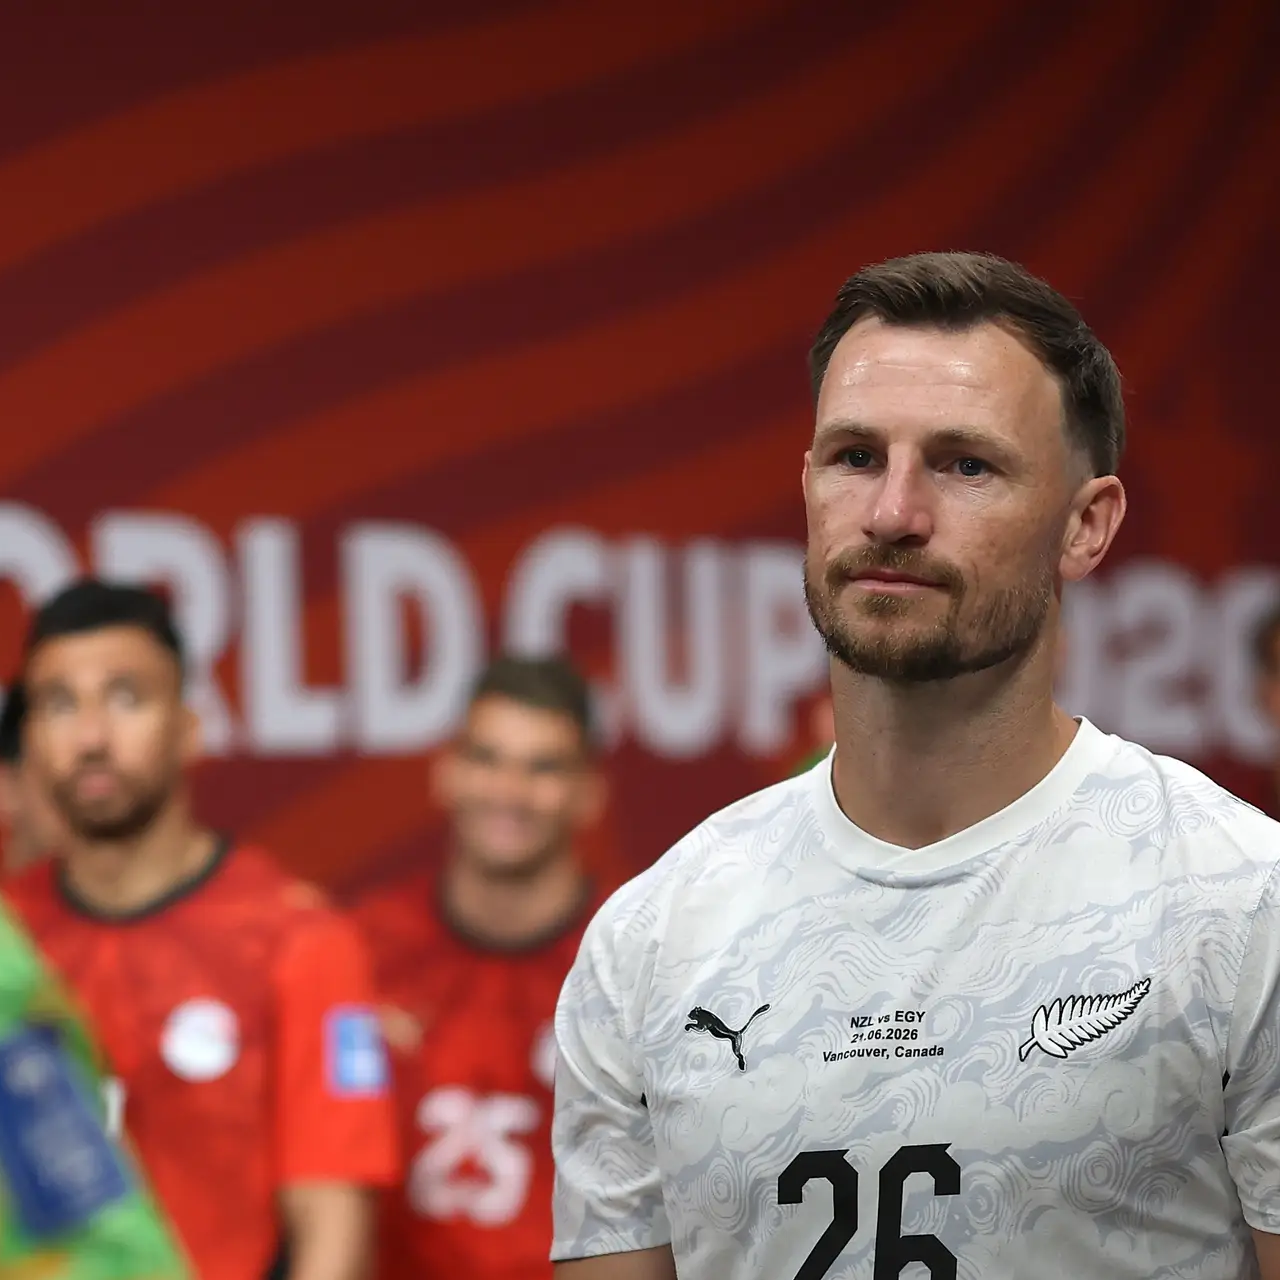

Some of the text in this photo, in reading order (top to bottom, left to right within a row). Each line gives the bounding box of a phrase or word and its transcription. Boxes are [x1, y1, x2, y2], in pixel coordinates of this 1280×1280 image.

[850, 1010, 926, 1029] NZL vs EGY
[850, 1028, 919, 1044] 21.06.2026
[822, 1044, 945, 1063] Vancouver, Canada
[408, 1086, 538, 1228] 25
